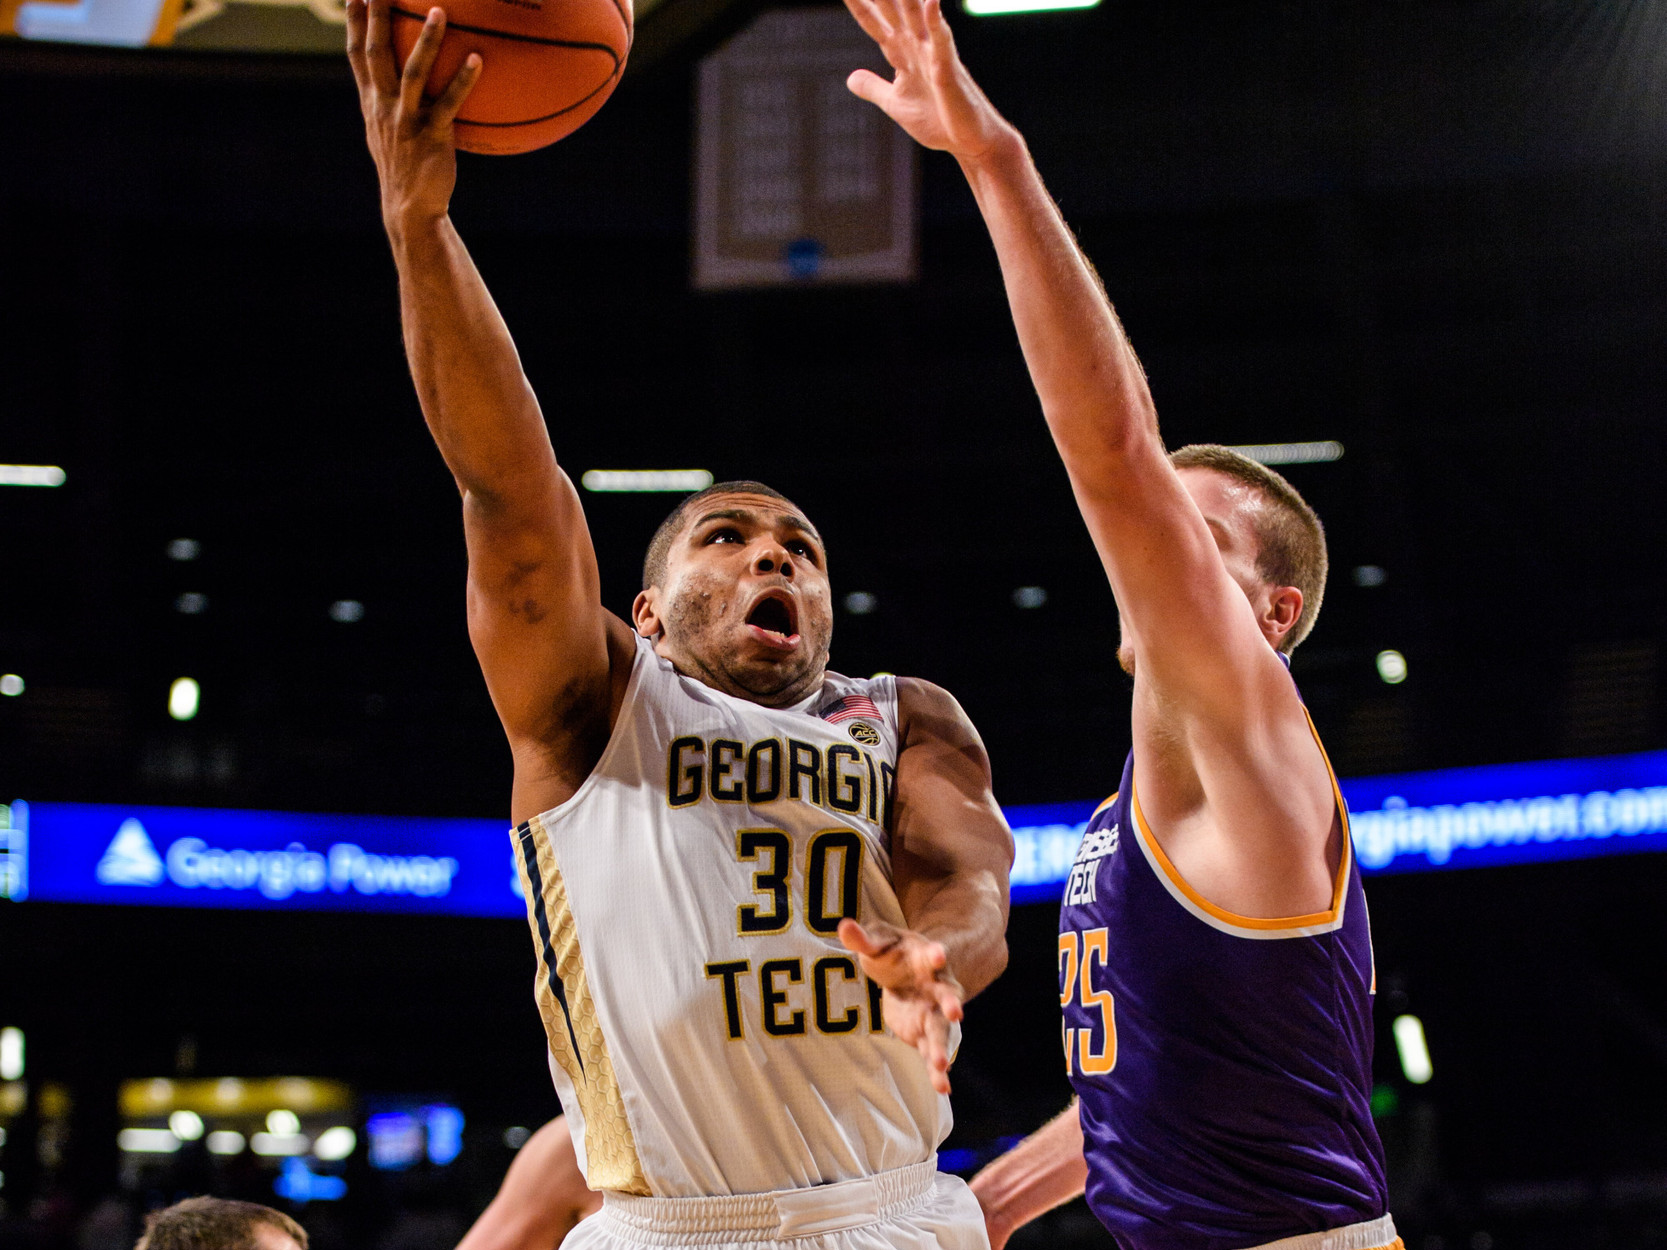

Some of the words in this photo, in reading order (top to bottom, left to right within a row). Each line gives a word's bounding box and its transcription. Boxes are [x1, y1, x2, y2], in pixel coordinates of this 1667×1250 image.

[855, 729, 877, 738] ACC
[168, 838, 327, 899] Georgia
[329, 844, 458, 896] Power
[737, 828, 866, 938] 30
